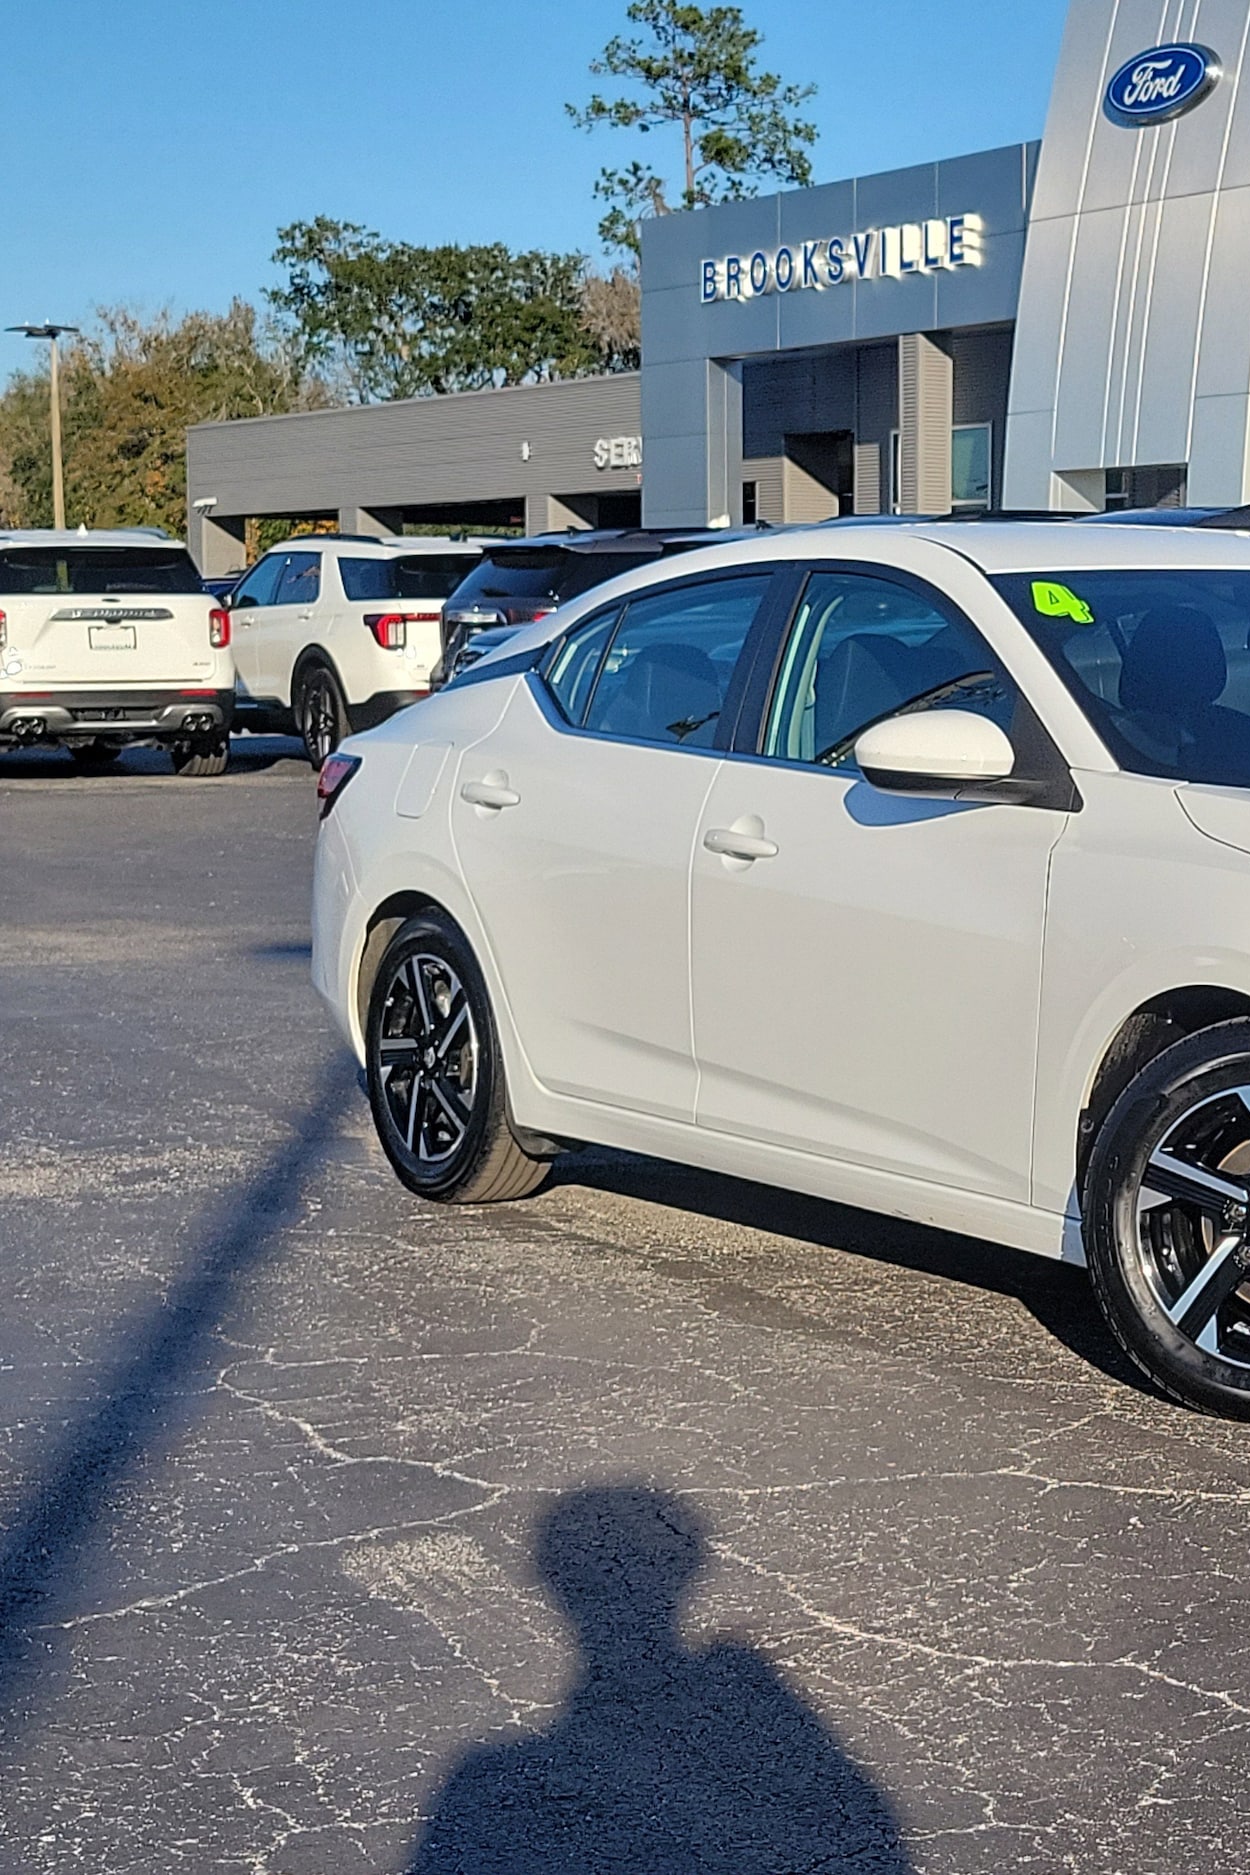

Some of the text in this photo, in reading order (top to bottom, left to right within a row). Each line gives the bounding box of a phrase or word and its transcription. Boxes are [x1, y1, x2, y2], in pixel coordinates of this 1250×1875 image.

[1123, 58, 1186, 106] Ford
[700, 214, 981, 303] BROOKSVILLE
[593, 436, 643, 468] SER
